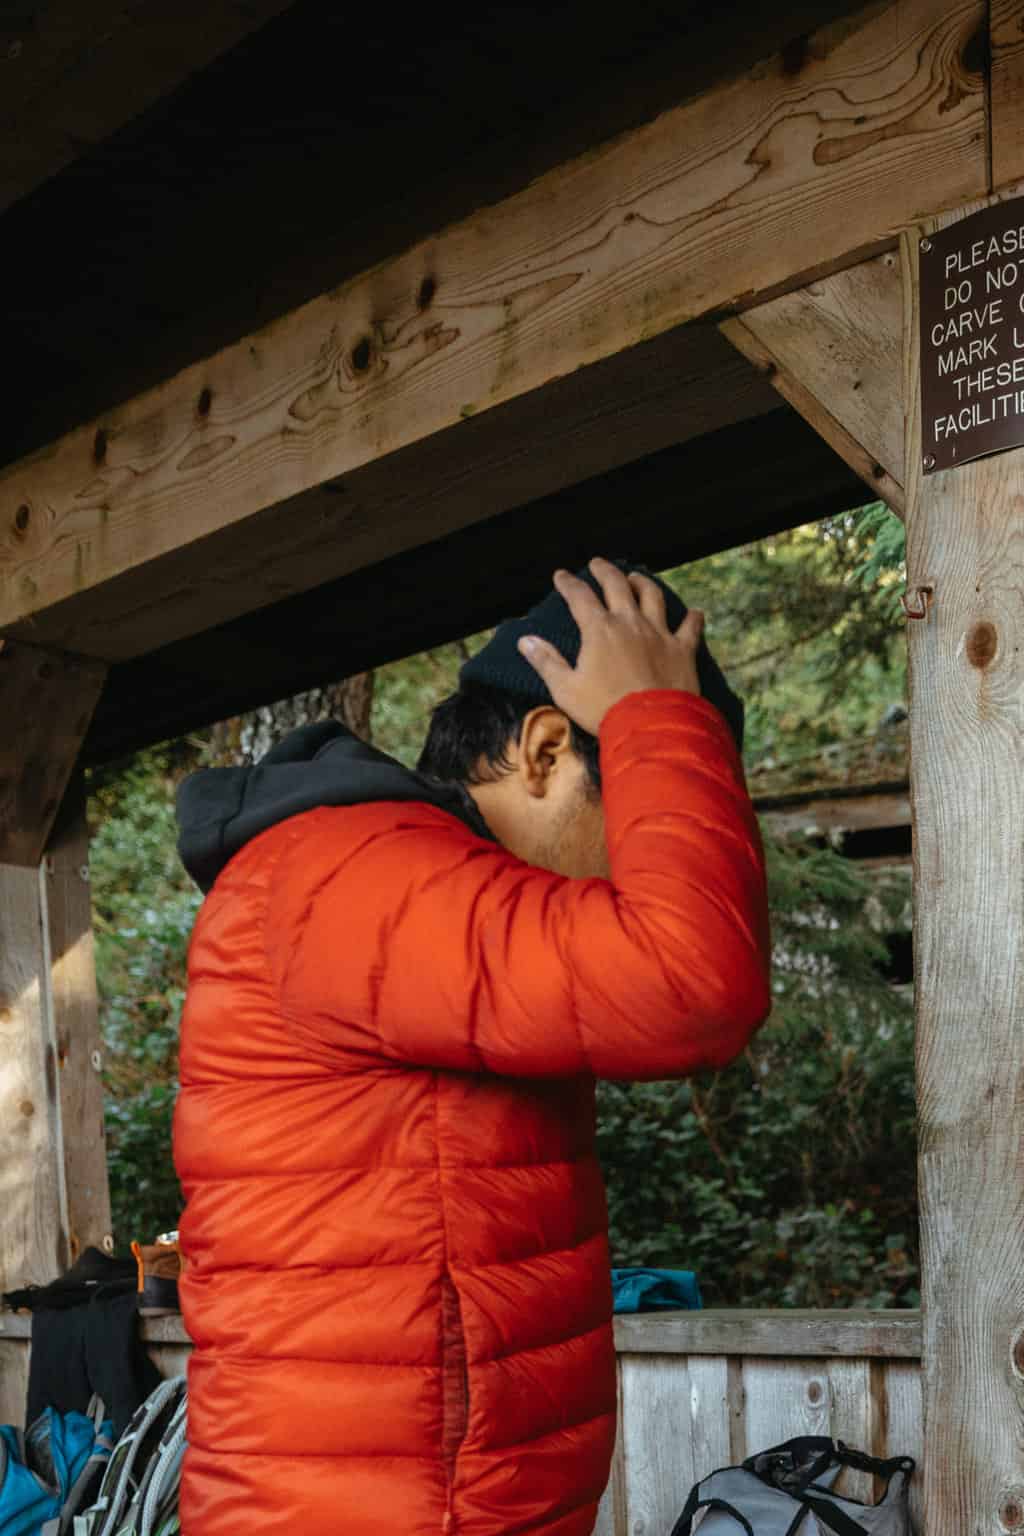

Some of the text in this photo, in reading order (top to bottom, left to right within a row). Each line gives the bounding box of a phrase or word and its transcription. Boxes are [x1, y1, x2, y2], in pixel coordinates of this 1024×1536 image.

[944, 280, 972, 311] DO
[931, 300, 1004, 347] CARVE
[938, 334, 999, 377] MARK
